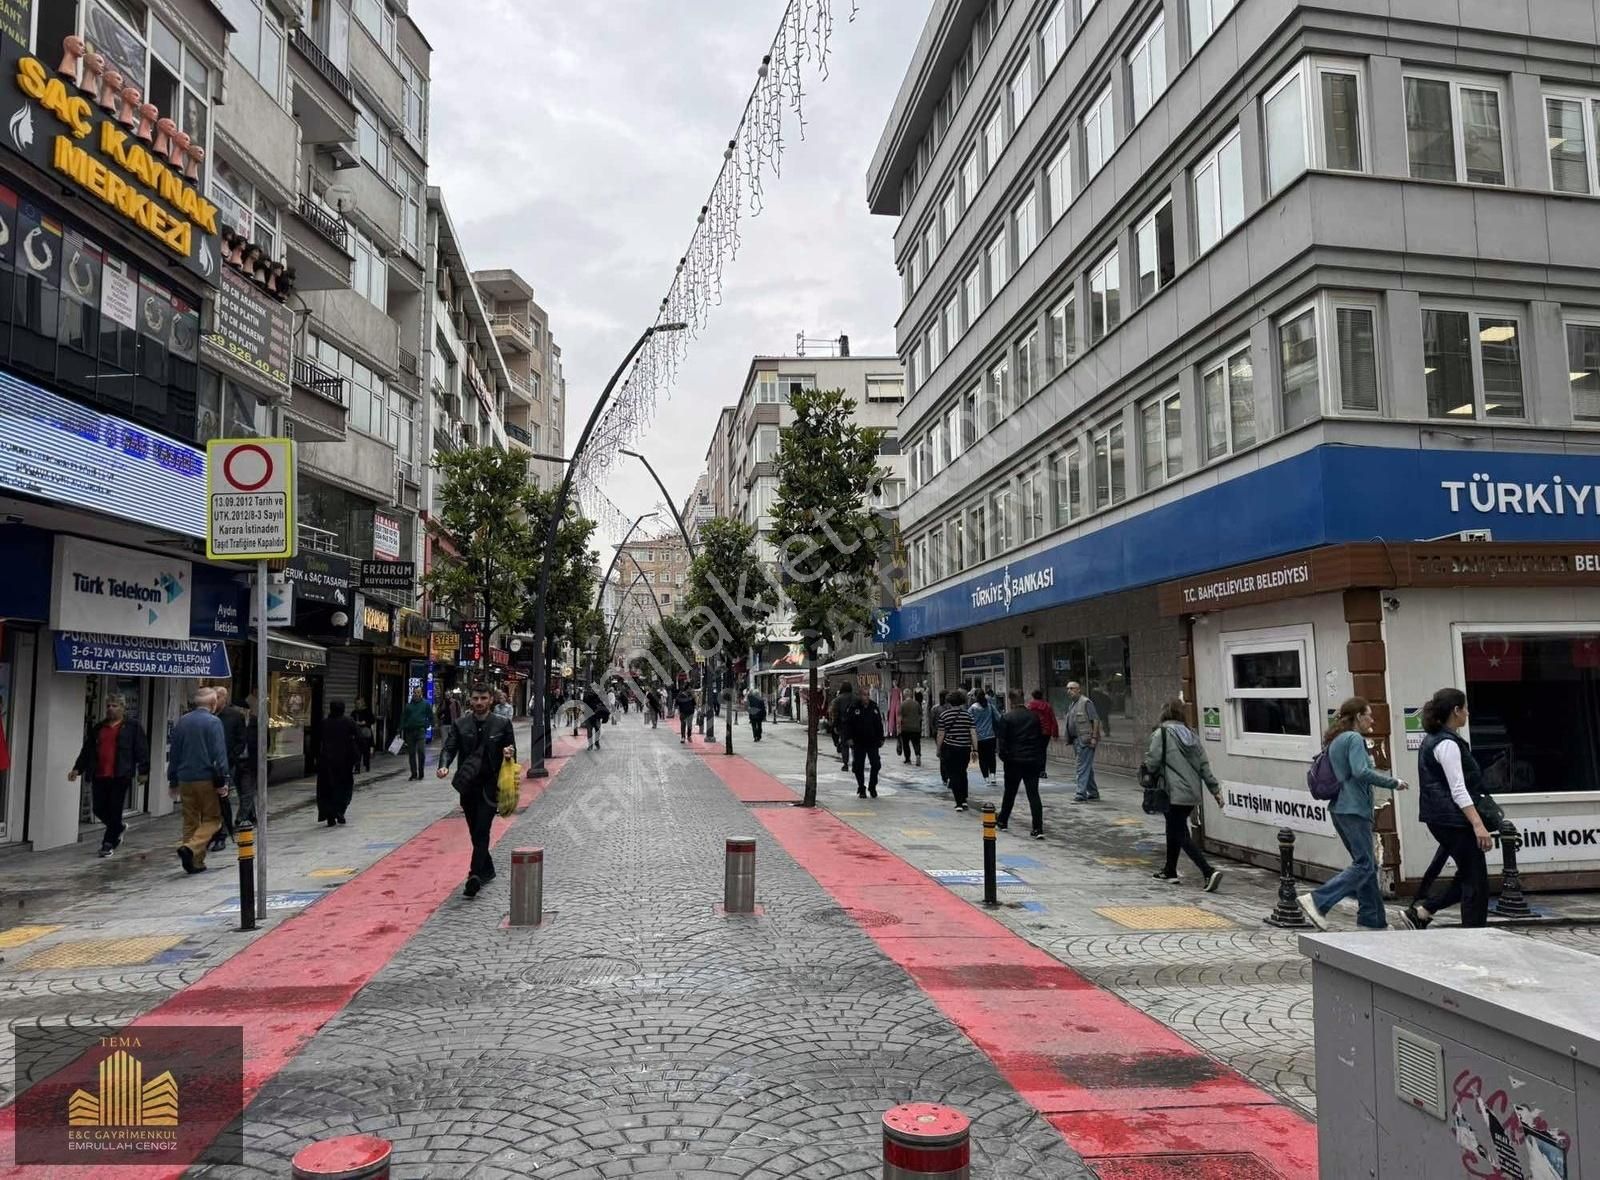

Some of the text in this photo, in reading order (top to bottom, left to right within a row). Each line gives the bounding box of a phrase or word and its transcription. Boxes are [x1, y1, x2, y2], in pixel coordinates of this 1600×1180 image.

[16, 57, 92, 139] SAÇ
[101, 121, 218, 236] KAYNAK
[230, 288, 240, 299] CM
[229, 302, 239, 313] CM
[228, 316, 238, 328] CM
[228, 331, 238, 342] CM
[255, 360, 270, 372] 40
[272, 369, 286, 382] 45
[214, 496, 253, 507] 13.09.2012
[255, 496, 273, 506] Tarih
[264, 509, 284, 521] Sayılı
[219, 522, 279, 535] Karara İstinaden
[214, 536, 285, 552] Taşıt Trafiğine Kapalıdır
[363, 564, 412, 575] ERZURUM
[72, 571, 162, 603] Türk Telekom
[309, 572, 322, 585] SAÇ
[323, 575, 349, 589] TASARIM
[971, 582, 1003, 609] TÜRKİYE
[1012, 567, 1054, 597] BANKASI
[1184, 561, 1309, 603] T.C. BAHÇELİEVLER BELEDİYESİ
[217, 603, 237, 618] Aydın
[215, 617, 239, 636] İletişim
[72, 645, 211, 664] 3-6-12 AY TAKSİTLE CEP TELEFONU
[72, 659, 156, 673] TABLET-AKSESUAR
[1228, 789, 1326, 822] İLETİŞİM NOKTASI
